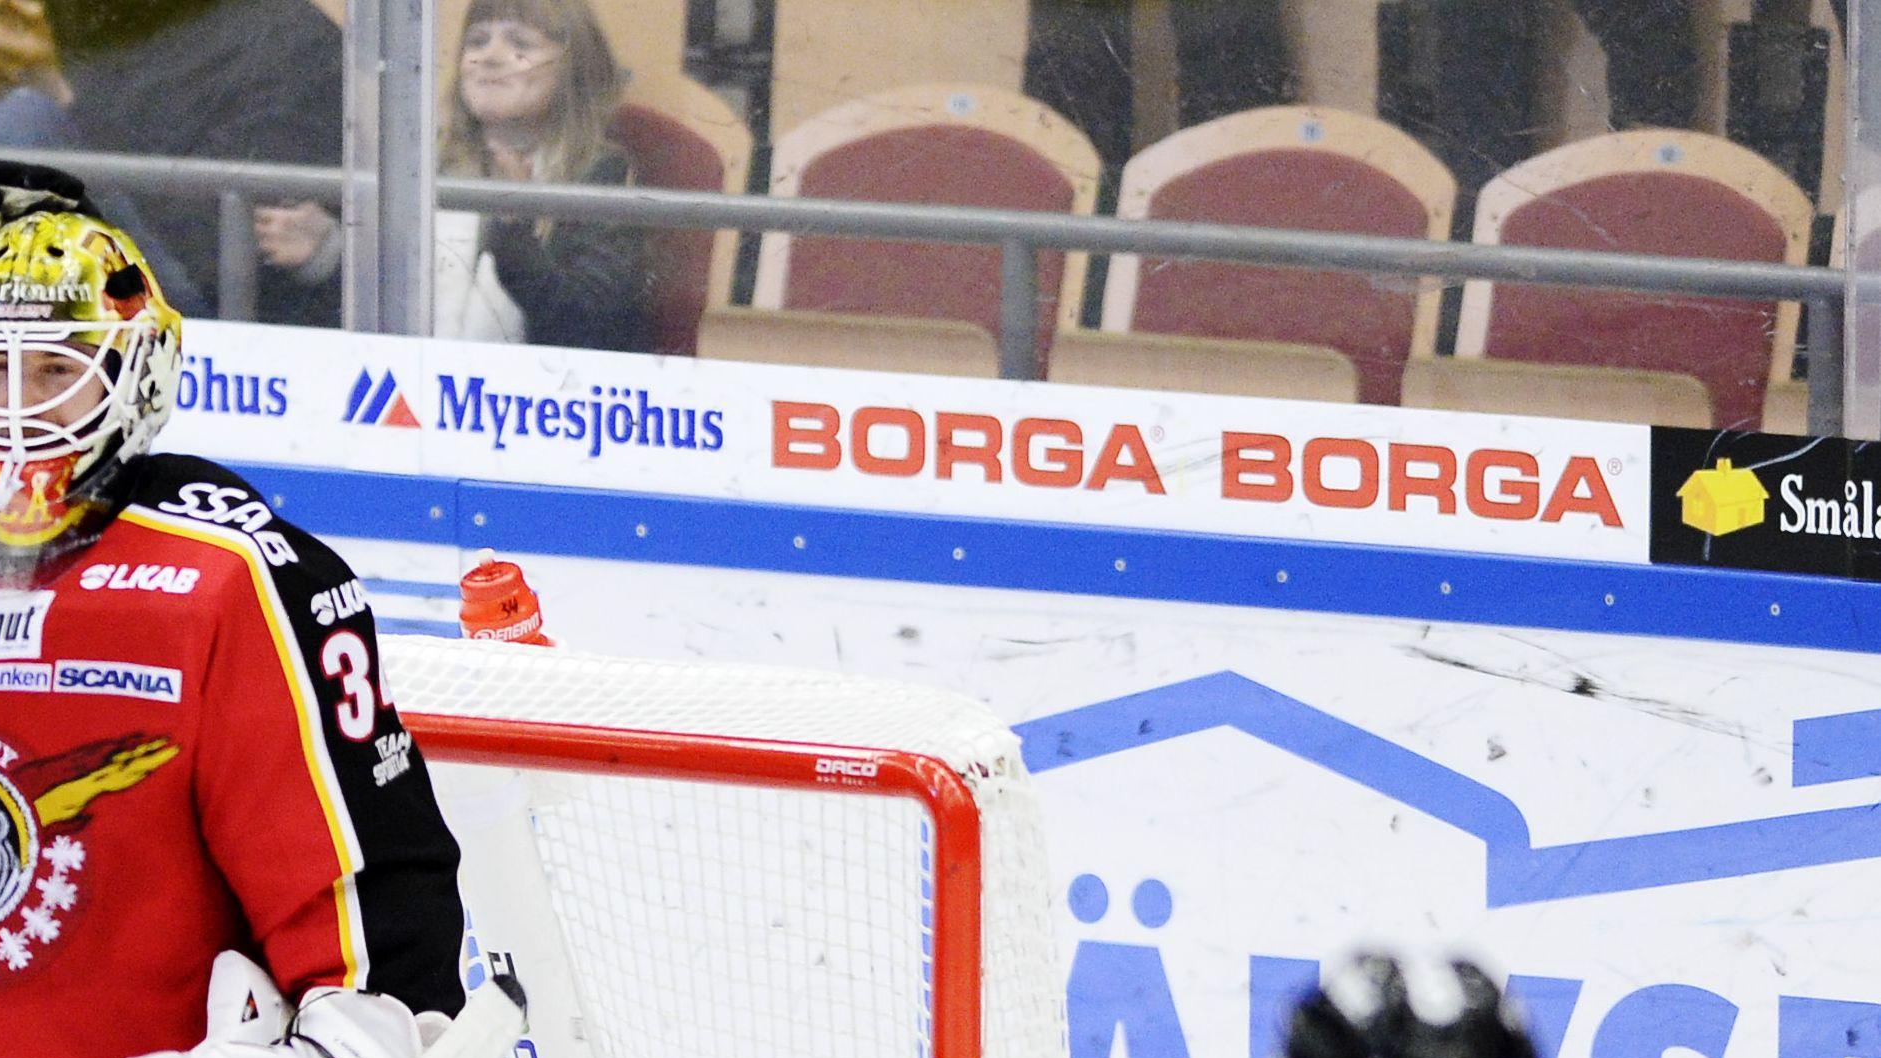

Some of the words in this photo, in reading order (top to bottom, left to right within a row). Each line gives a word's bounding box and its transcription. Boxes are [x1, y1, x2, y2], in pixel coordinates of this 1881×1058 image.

[437, 374, 725, 457] Myresjöhus
[771, 400, 1166, 495] BORGA
[1222, 430, 1625, 530] BORGA
[158, 482, 299, 567] SSAB
[102, 563, 201, 594] LKAB
[58, 667, 174, 695] SCANIA
